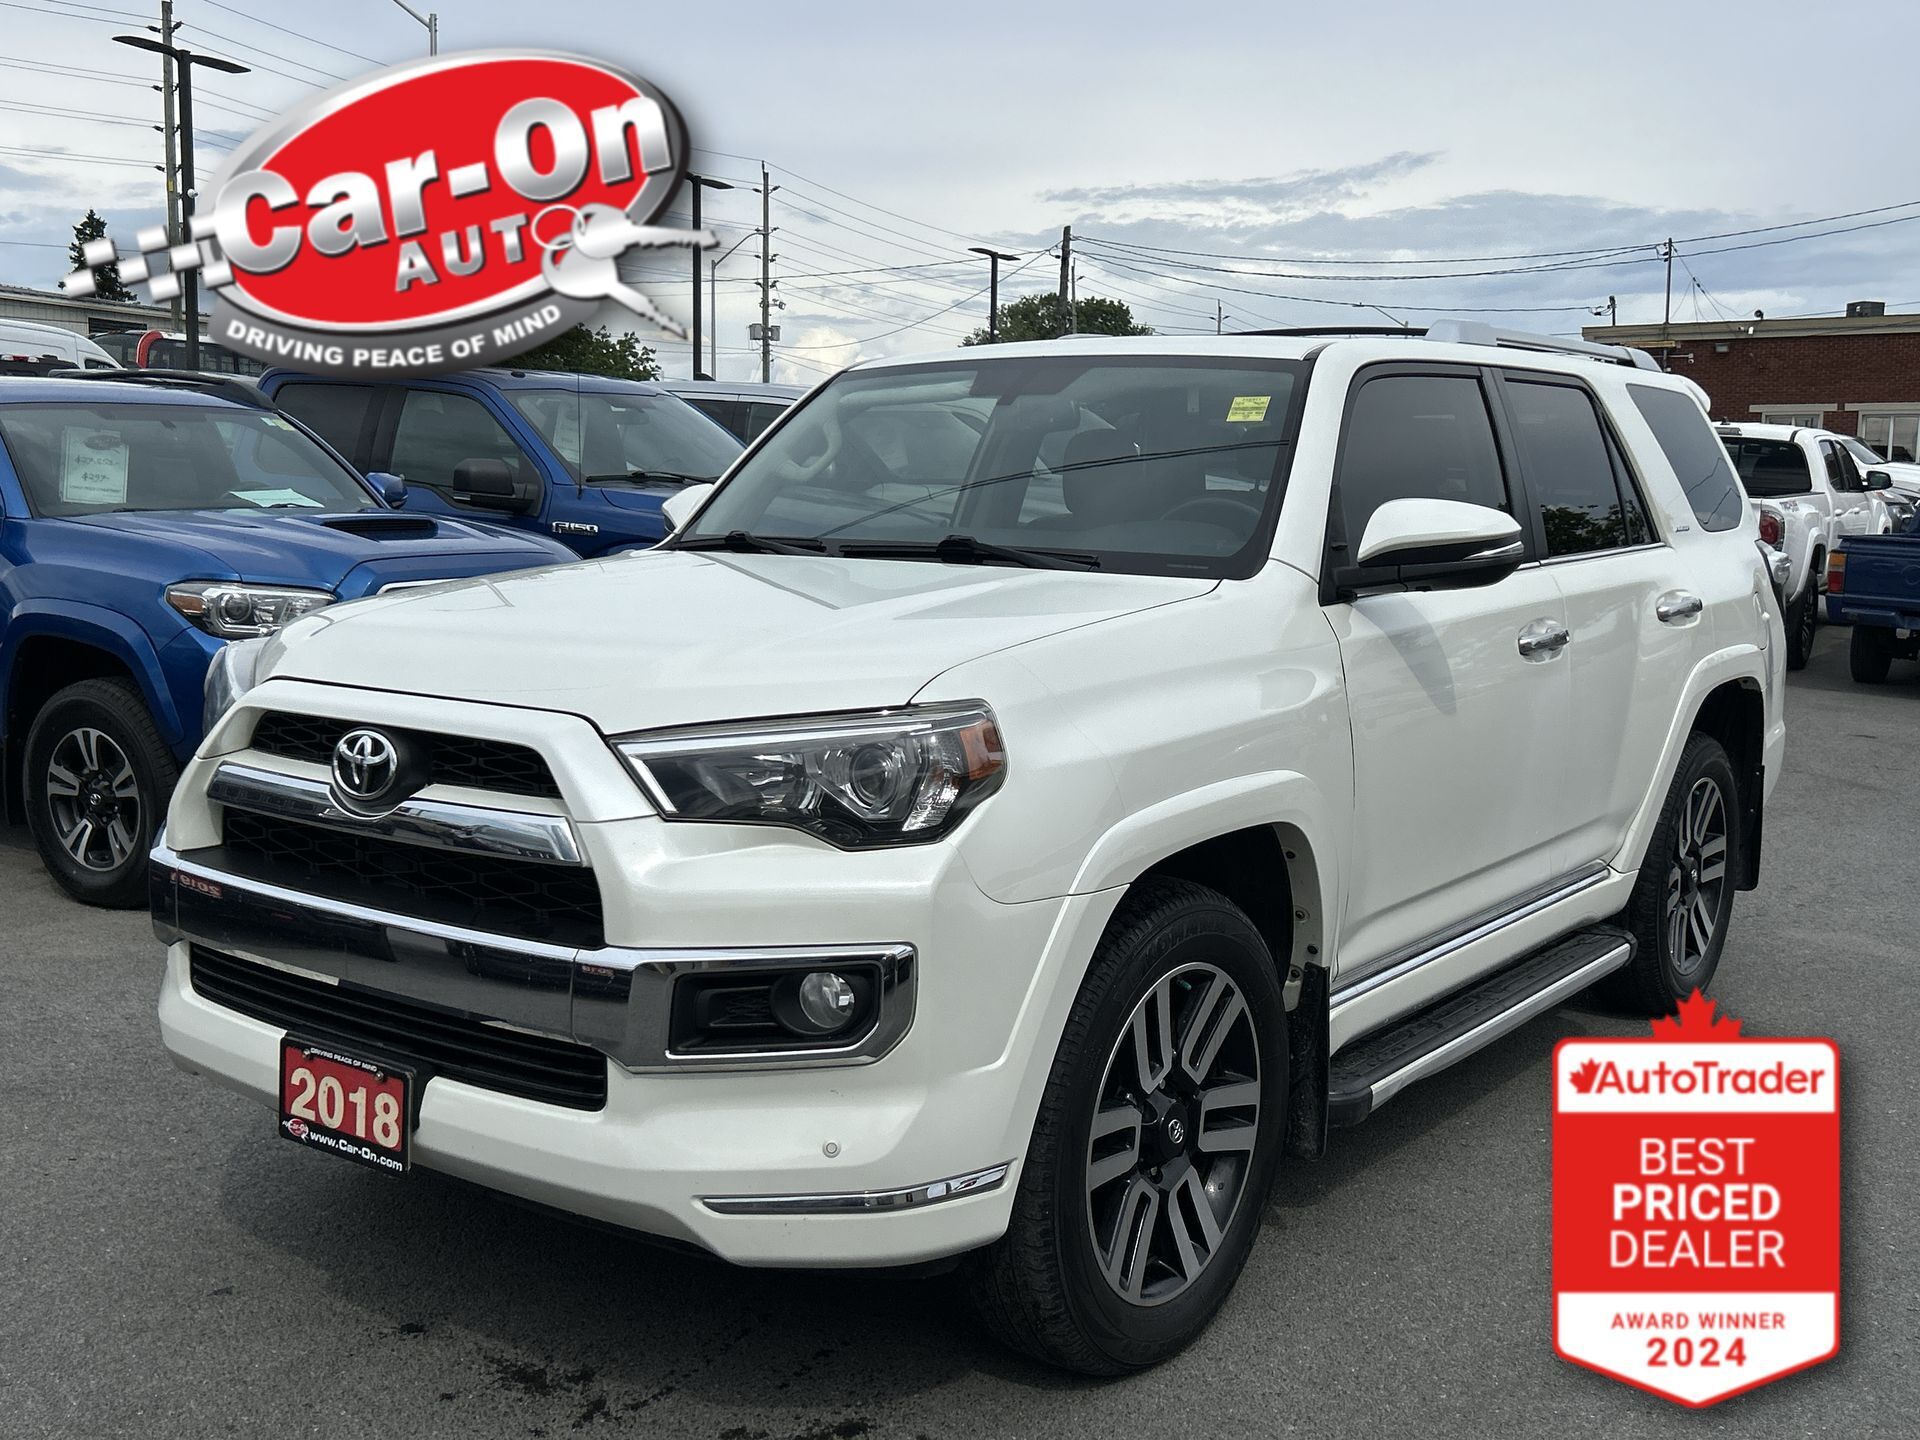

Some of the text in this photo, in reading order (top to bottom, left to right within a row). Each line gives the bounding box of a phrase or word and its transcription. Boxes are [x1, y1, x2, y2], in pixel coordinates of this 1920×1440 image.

[310, 1048, 333, 1059] DRIVING
[334, 1054, 352, 1064] PEACE
[362, 1063, 377, 1072] MIND
[290, 1067, 399, 1148] 2018
[310, 1131, 403, 1171] www.Car-On.com
